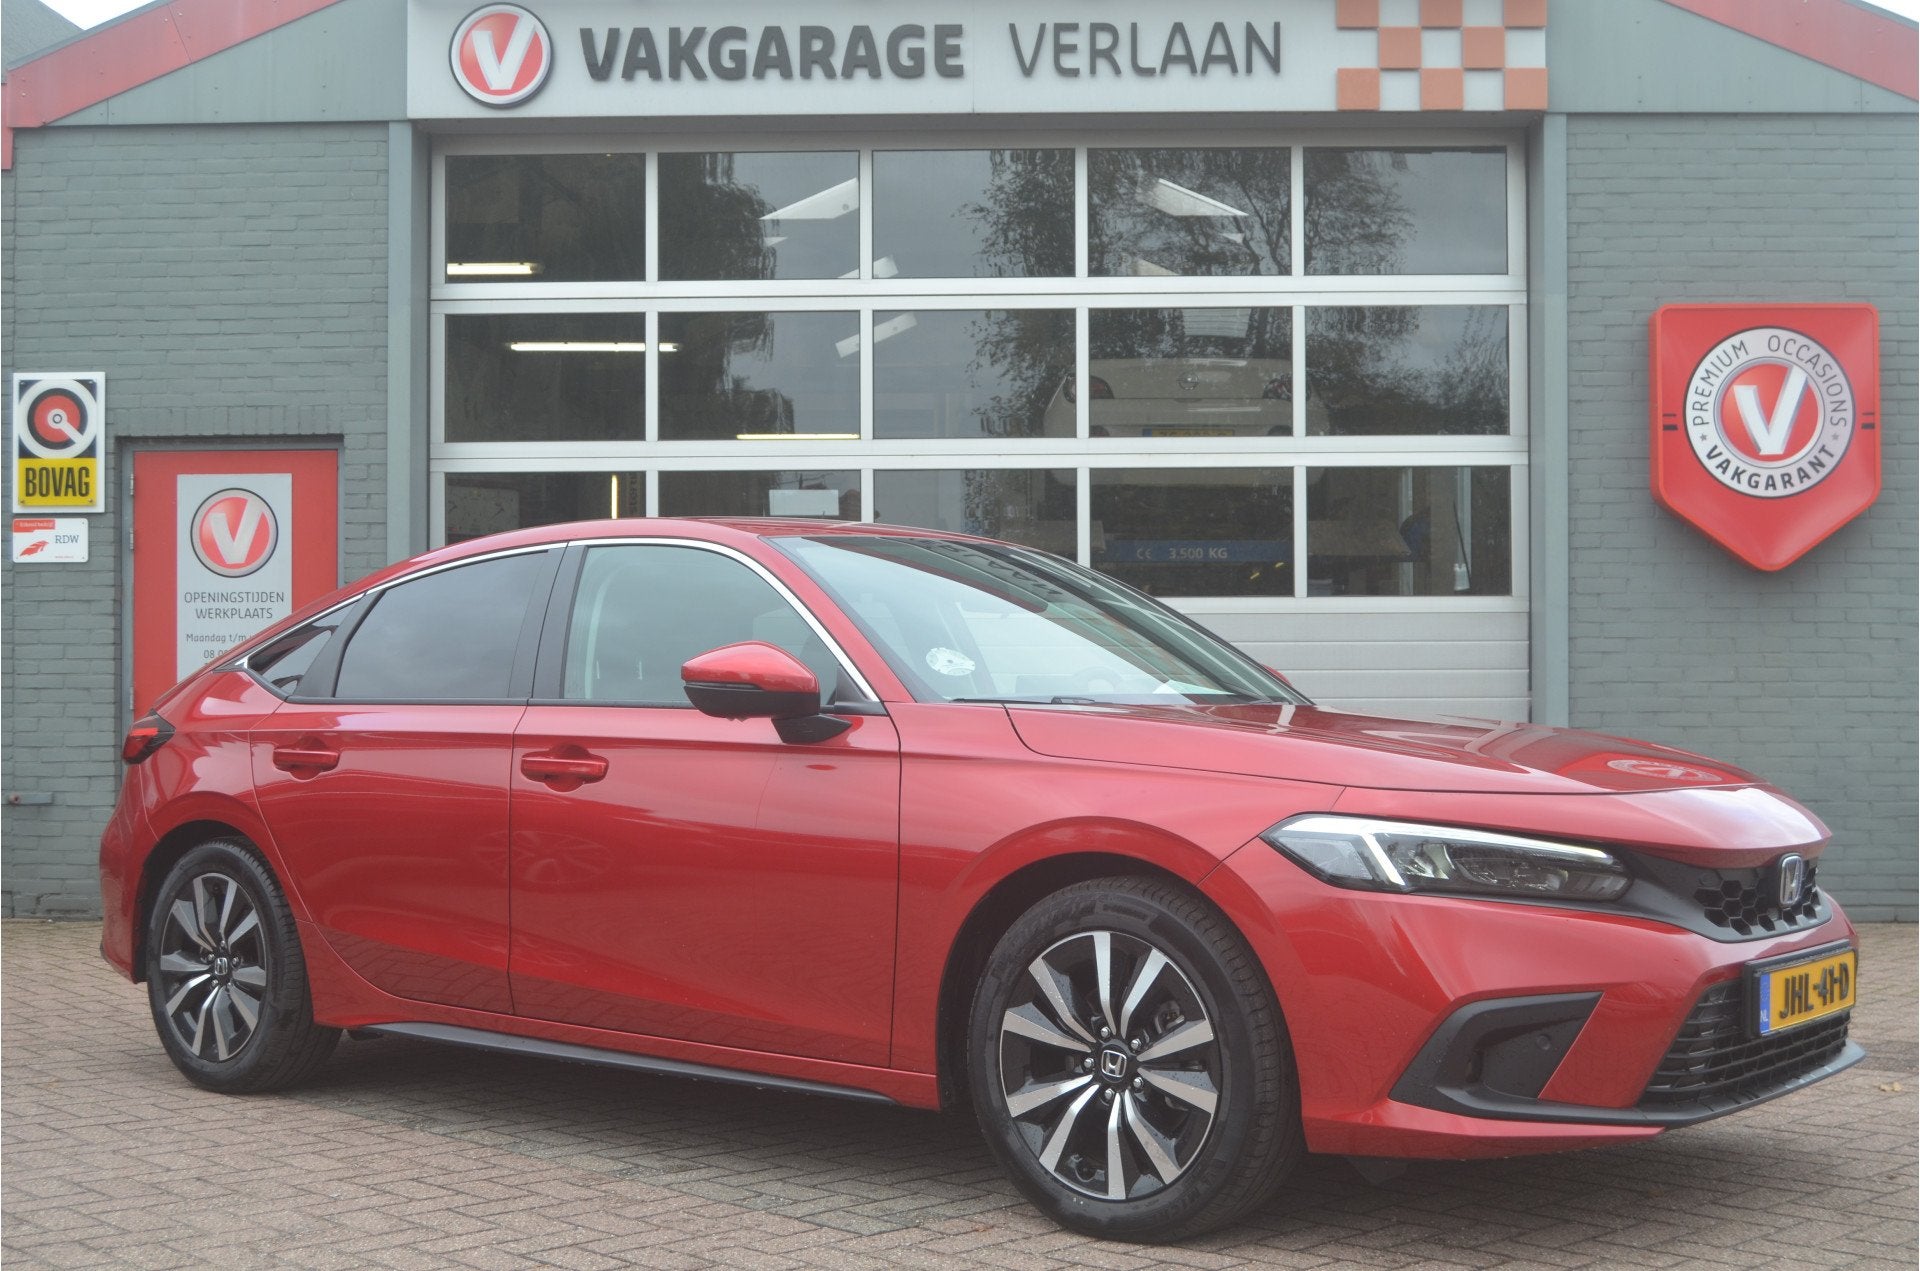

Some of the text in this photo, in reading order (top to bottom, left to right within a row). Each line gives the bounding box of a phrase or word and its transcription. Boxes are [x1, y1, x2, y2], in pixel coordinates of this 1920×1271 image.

[579, 21, 1281, 82] VAKGARAGE VERLAAN
[1692, 335, 1847, 427] PREMIUM OCCASIONS
[1706, 444, 1835, 491] VAKGARANT
[25, 467, 90, 498] BOVAG
[55, 534, 79, 544] RDW
[1168, 547, 1203, 559] 3.500
[1209, 547, 1227, 559] KG
[184, 591, 284, 603] OPENINGSTIJDEN
[195, 607, 273, 619] WERKPLAATS
[186, 633, 226, 643] Maandag
[1779, 962, 1849, 1019] JHL-41-D
